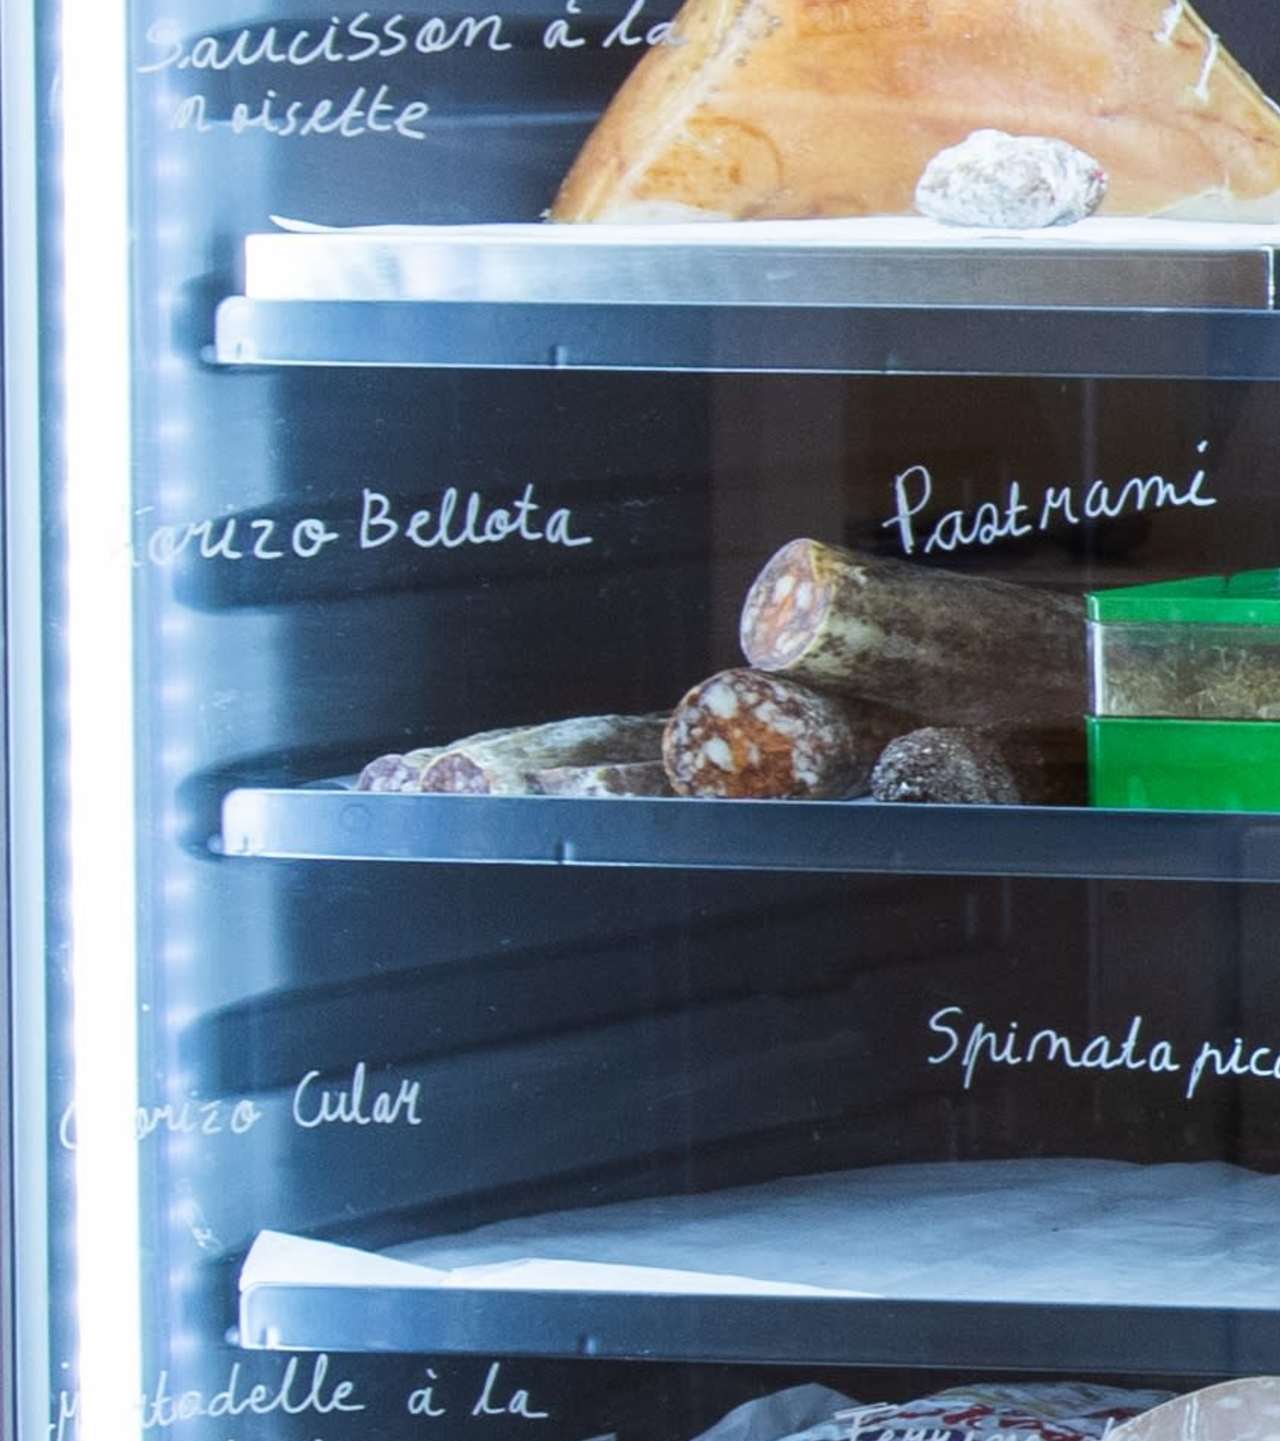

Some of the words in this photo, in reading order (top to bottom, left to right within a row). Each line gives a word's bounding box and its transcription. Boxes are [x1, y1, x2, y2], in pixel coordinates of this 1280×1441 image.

[136, 12, 511, 74] Saucisson
[130, 505, 339, 566] orizo
[358, 483, 593, 548] Bellota
[880, 440, 1219, 556] Pastrami
[58, 1091, 262, 1152] Corizo
[292, 1061, 423, 1128] Cular
[406, 1369, 446, 1418] à
[472, 1361, 550, 1420] la
